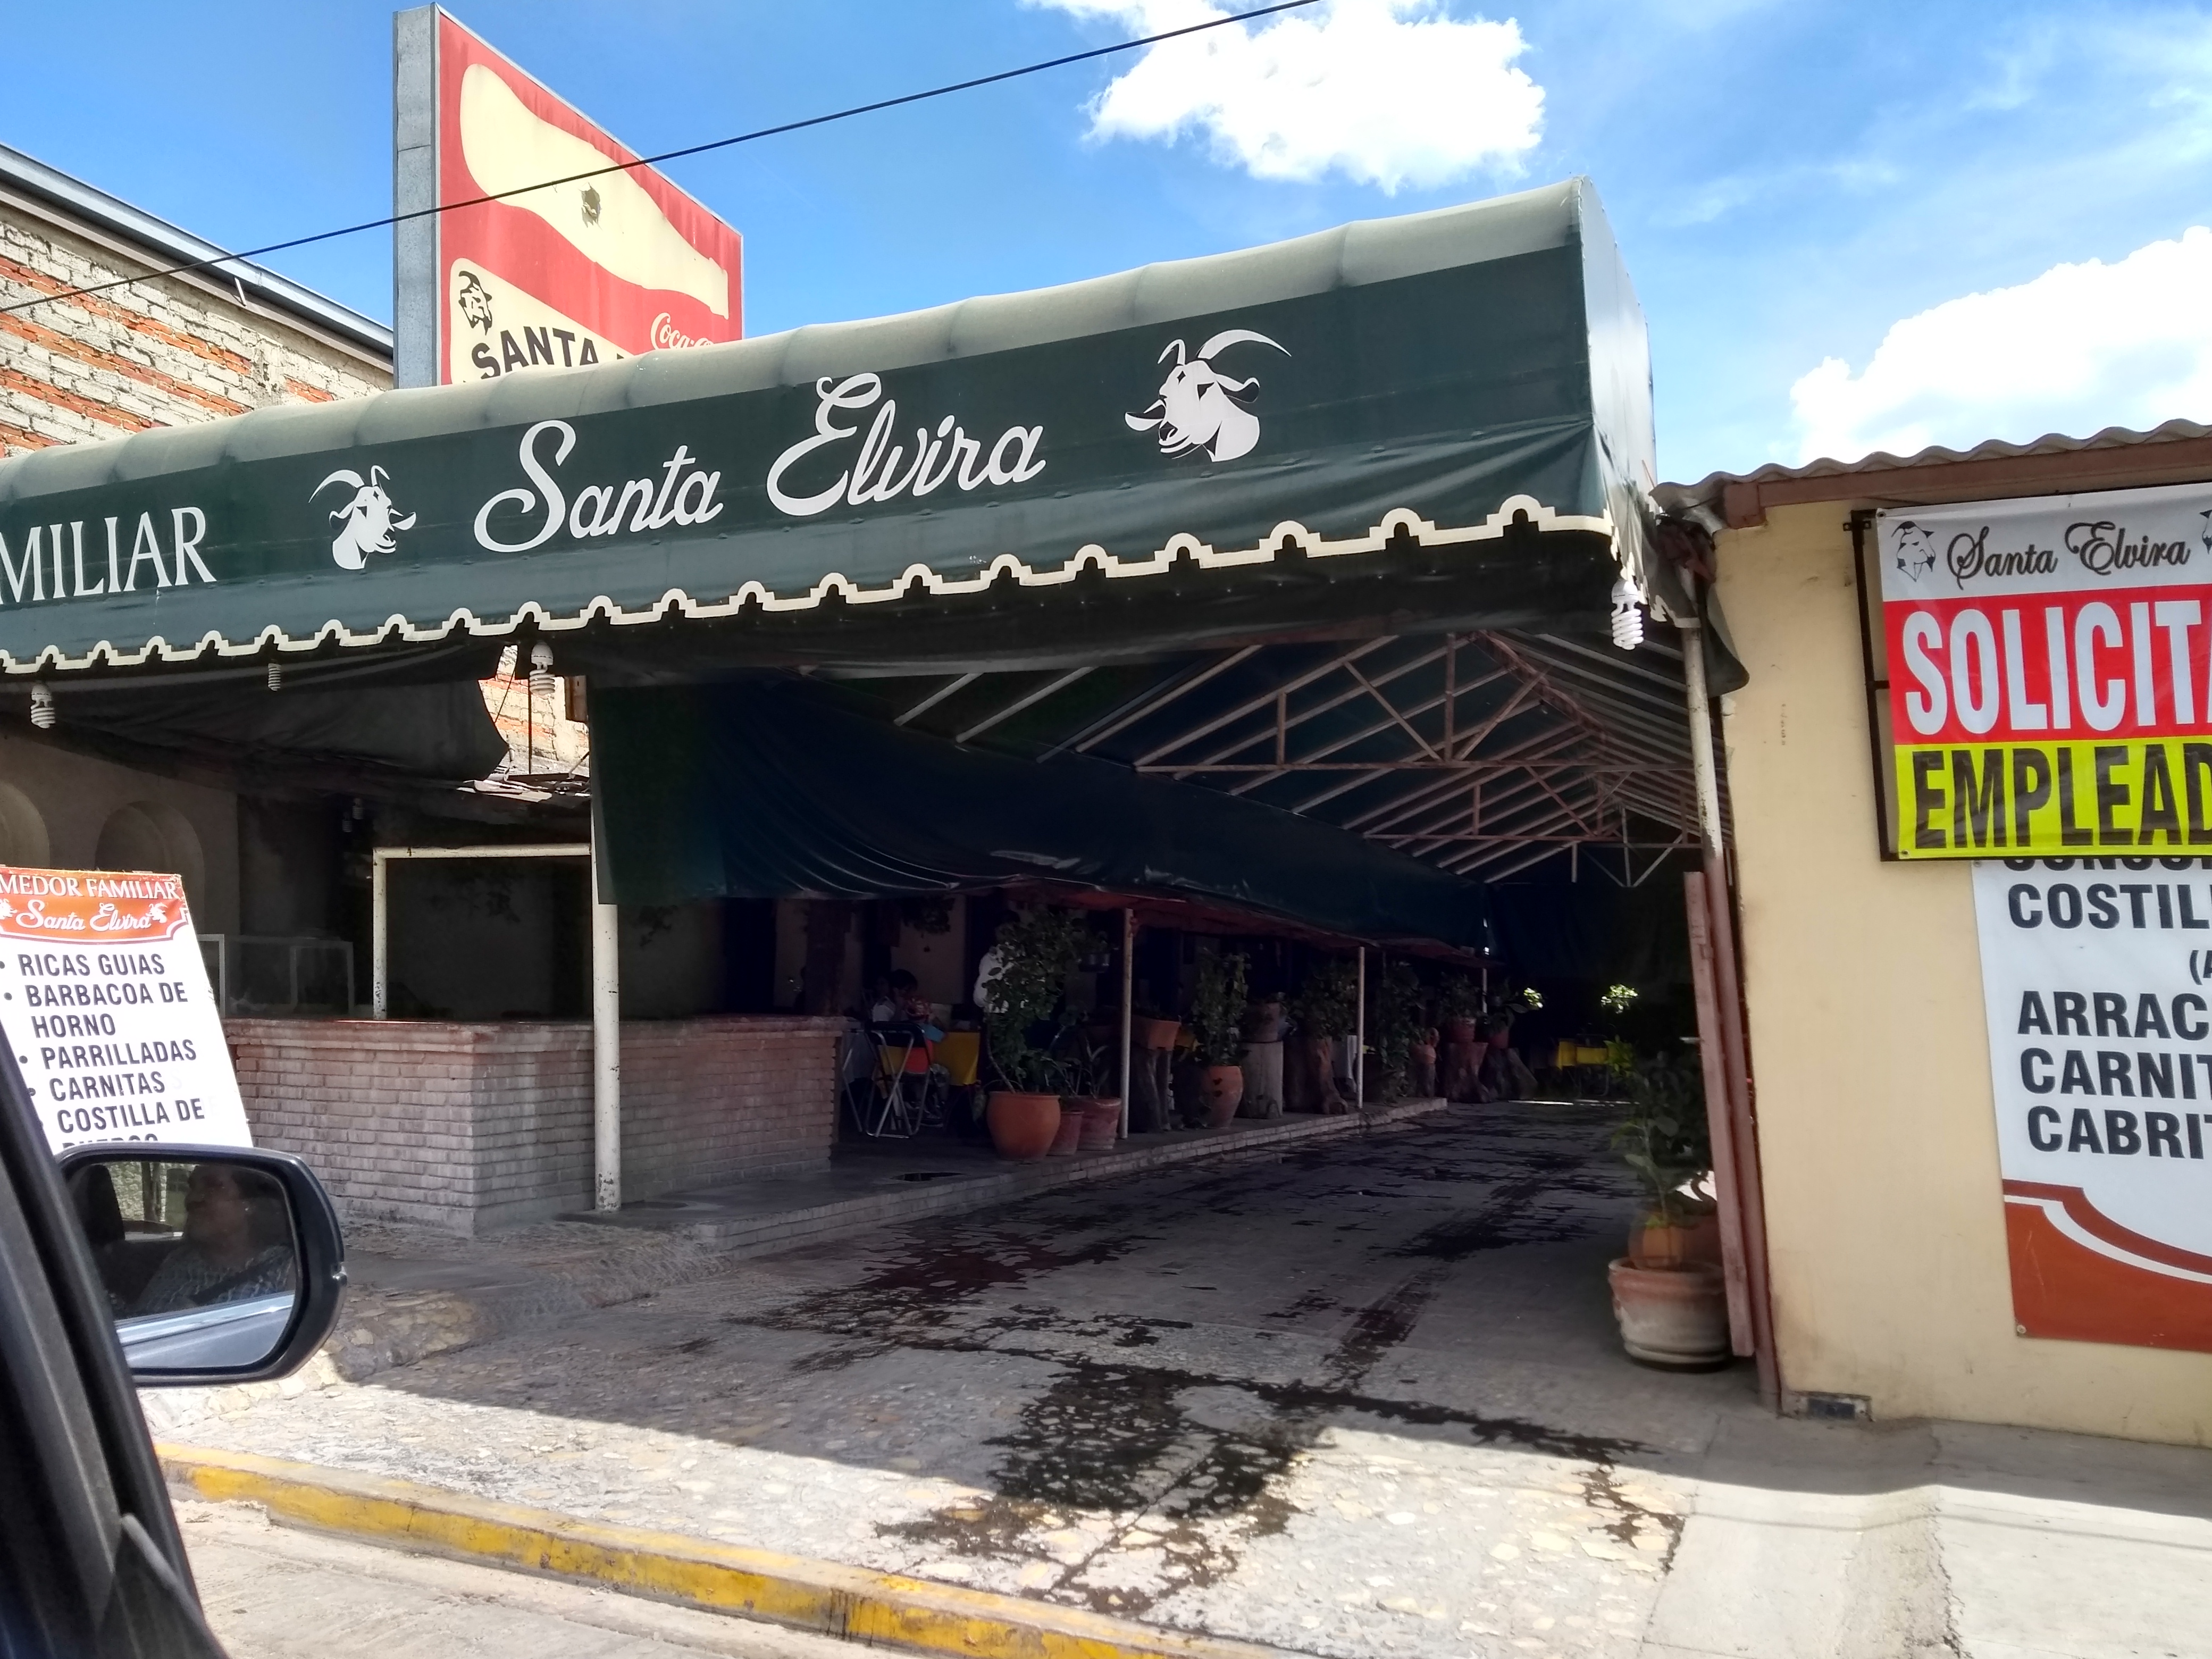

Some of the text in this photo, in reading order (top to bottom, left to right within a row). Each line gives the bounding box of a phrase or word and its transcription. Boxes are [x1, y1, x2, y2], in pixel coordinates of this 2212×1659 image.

[471, 326, 599, 380] SANTA
[473, 372, 1046, 552] Santa Elvira
[0, 506, 217, 604] MILIAR
[1947, 521, 2191, 590] Santa Elvira
[1903, 600, 2212, 736] SOLICIT
[0, 874, 180, 900] MEDOR FAMILIAR
[15, 899, 152, 932] Santa Elvira
[2008, 883, 2212, 929] COSTIL
[17, 953, 165, 976] RICAS GUIAS
[24, 982, 188, 1007] BARBACOA DE
[30, 1013, 116, 1038] HORNO
[40, 1039, 197, 1070] PARRILLADAS
[49, 1070, 165, 1102] CARNITAS
[56, 1098, 205, 1134] COSTILLA DE
